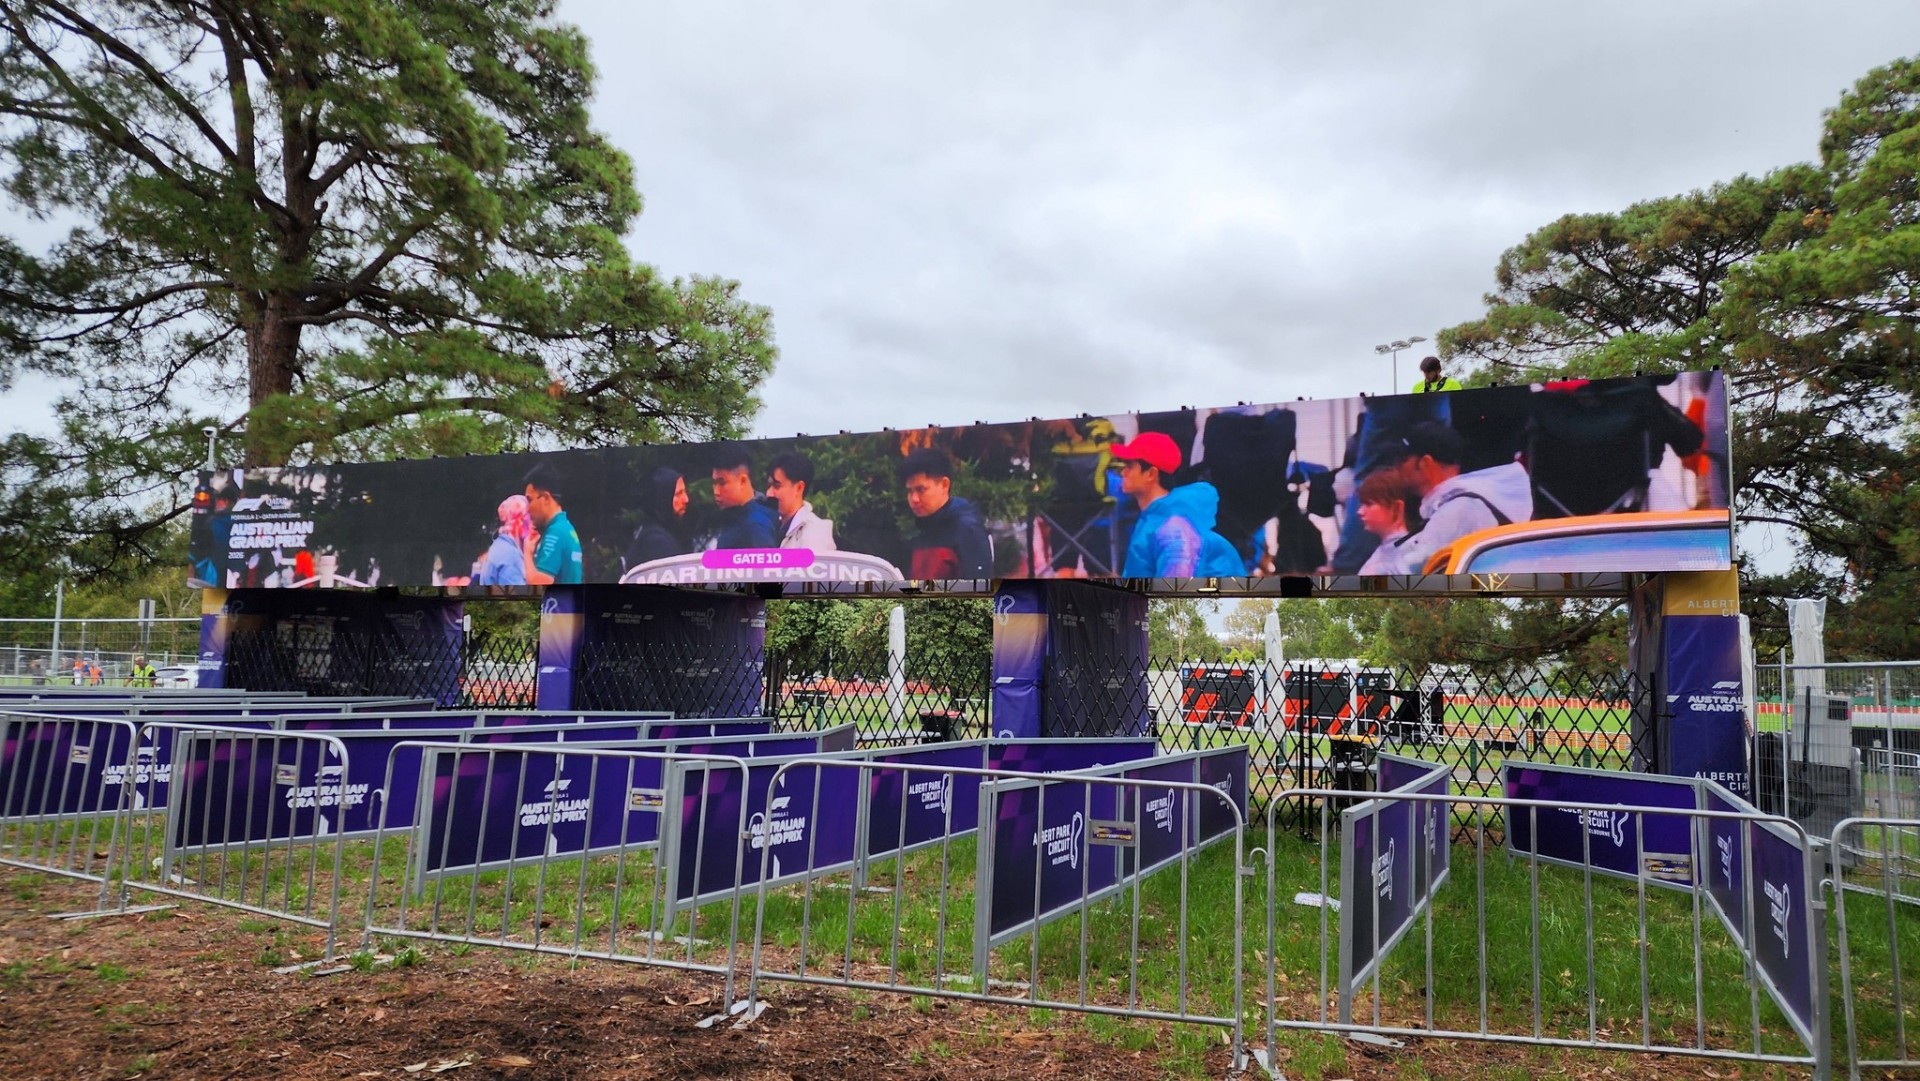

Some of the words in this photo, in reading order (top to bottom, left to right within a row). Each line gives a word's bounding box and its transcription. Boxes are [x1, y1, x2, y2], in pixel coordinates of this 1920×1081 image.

[230, 521, 314, 536] AUSTRALIAN
[229, 536, 275, 548] GRAND
[275, 535, 307, 547] PRIX
[733, 553, 764, 564] GATE
[766, 553, 782, 564] 10
[637, 566, 752, 584] MARTINI
[762, 563, 883, 585] RACING
[1688, 600, 1735, 609] ALBERT
[1690, 703, 1735, 712] GRAND
[1695, 771, 1742, 781] ALBERT
[908, 782, 928, 795] ALBERT
[929, 780, 941, 791] PARK
[921, 790, 941, 803] CIRCUIT
[519, 798, 590, 815] AUSTRALIAN
[1588, 808, 1610, 819] PARK
[521, 813, 560, 827] GRAND
[561, 809, 587, 823] PRIX
[1578, 815, 1610, 829] CRCUIT
[751, 816, 805, 836] AUTRALIAN
[1588, 828, 1611, 838] ELBOURNE
[751, 832, 783, 849] GRND
[783, 829, 803, 844] PRIX
[1032, 827, 1056, 846] ABERT
[1056, 824, 1071, 839] PARK
[1048, 837, 1071, 856] CIRCUIT
